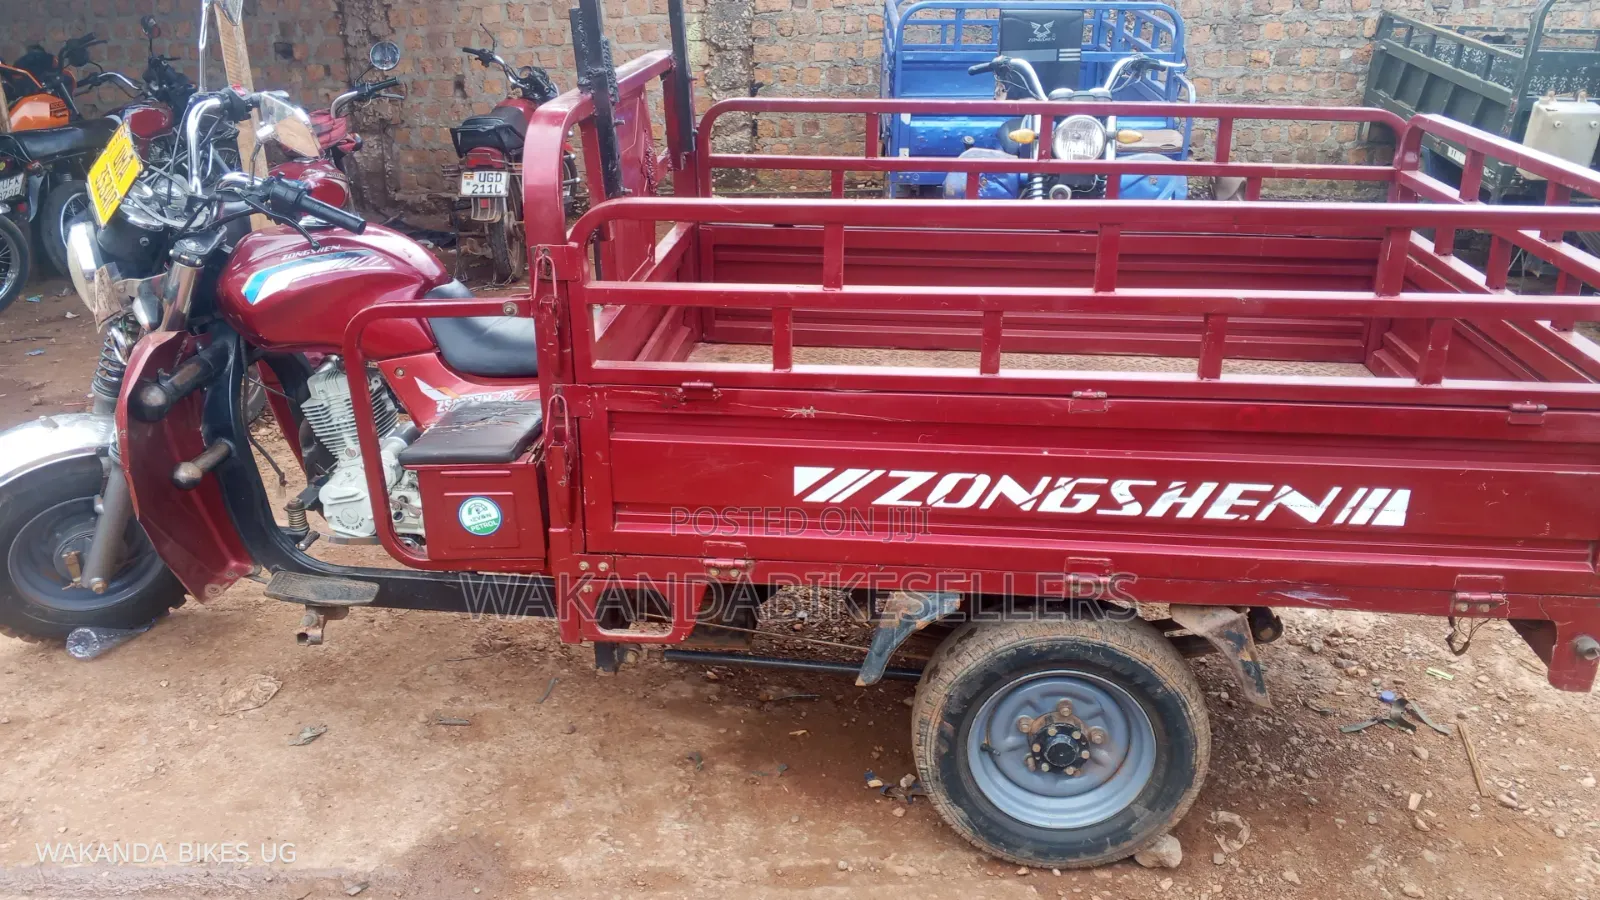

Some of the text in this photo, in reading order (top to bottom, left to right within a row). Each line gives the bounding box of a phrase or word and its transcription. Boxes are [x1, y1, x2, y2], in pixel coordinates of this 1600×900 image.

[478, 172, 503, 183] UGD
[471, 184, 502, 195] 211L
[872, 470, 1343, 524] ZONGSHEN
[470, 520, 499, 532] PETROL
